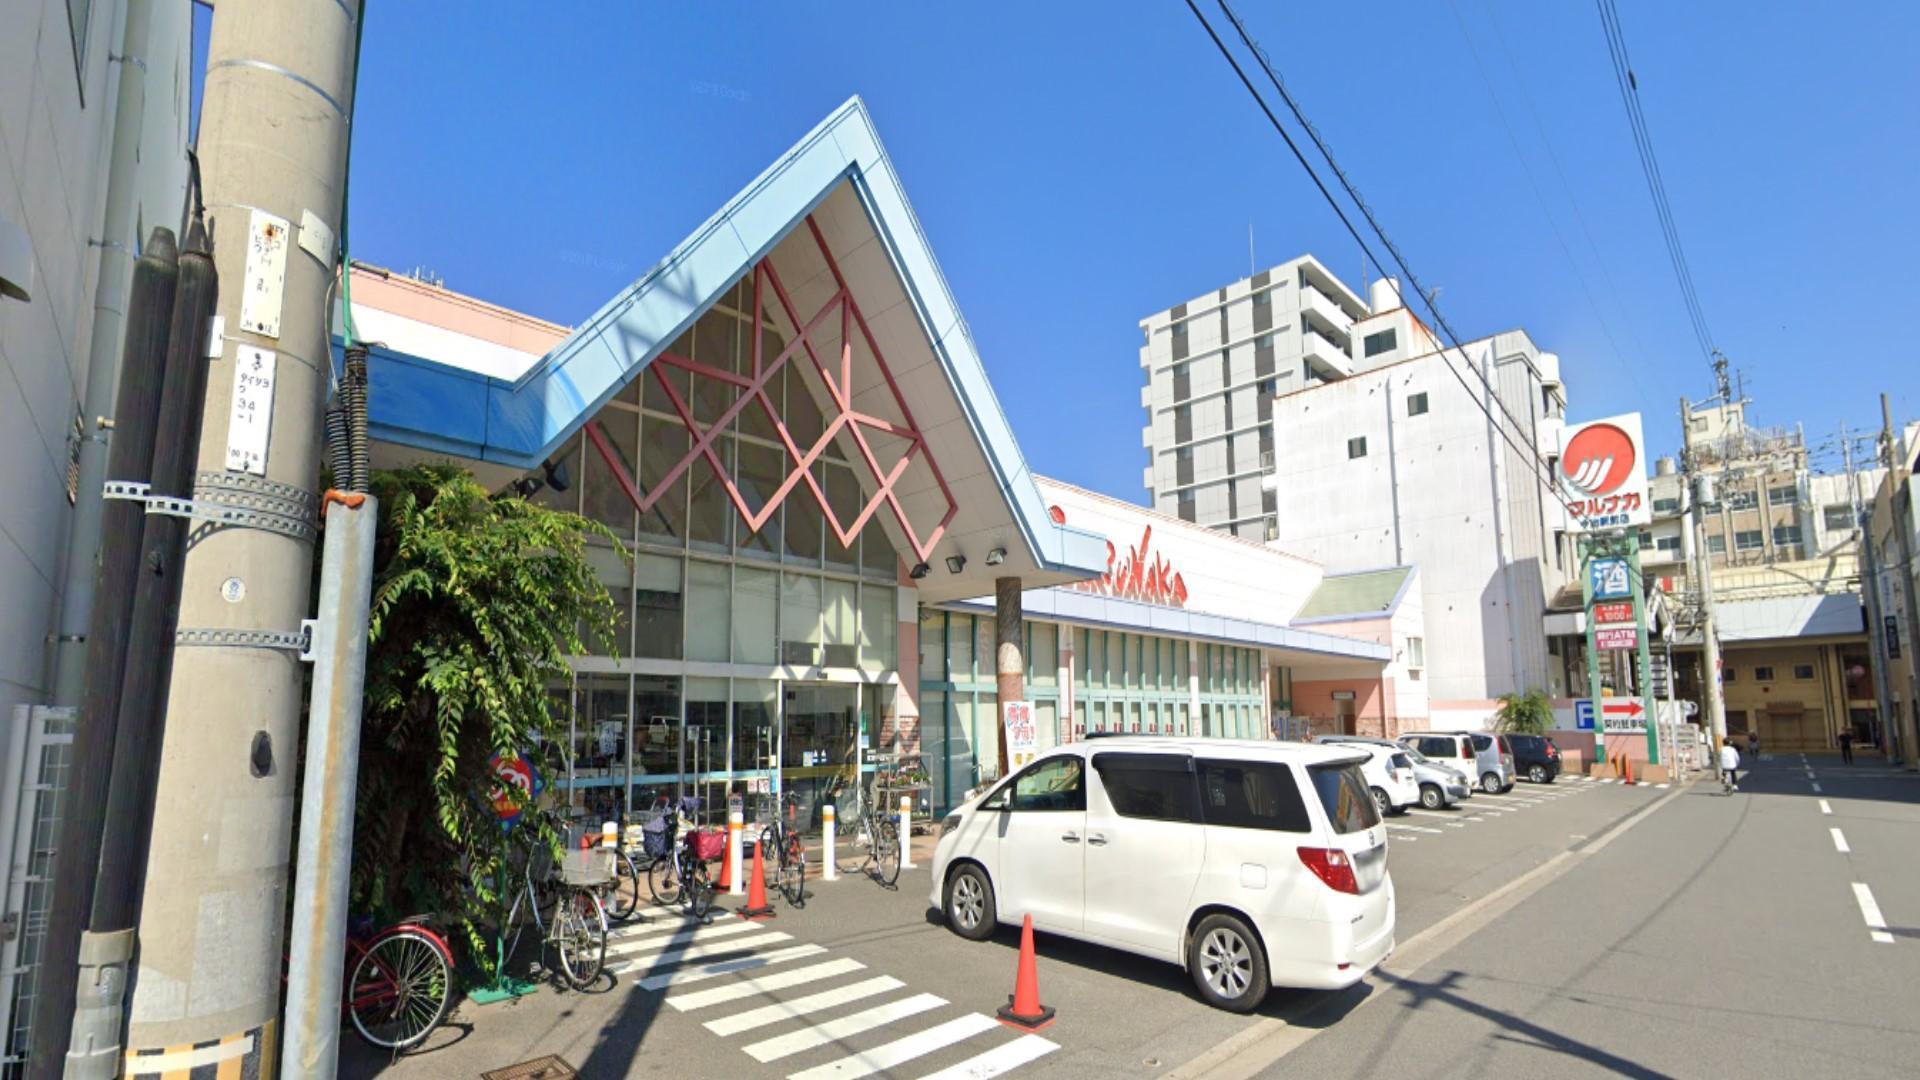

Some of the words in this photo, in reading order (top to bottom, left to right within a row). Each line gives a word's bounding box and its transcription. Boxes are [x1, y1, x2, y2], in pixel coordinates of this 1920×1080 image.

[1567, 492, 1641, 517] マルナカ
[1594, 561, 1630, 595] 酒
